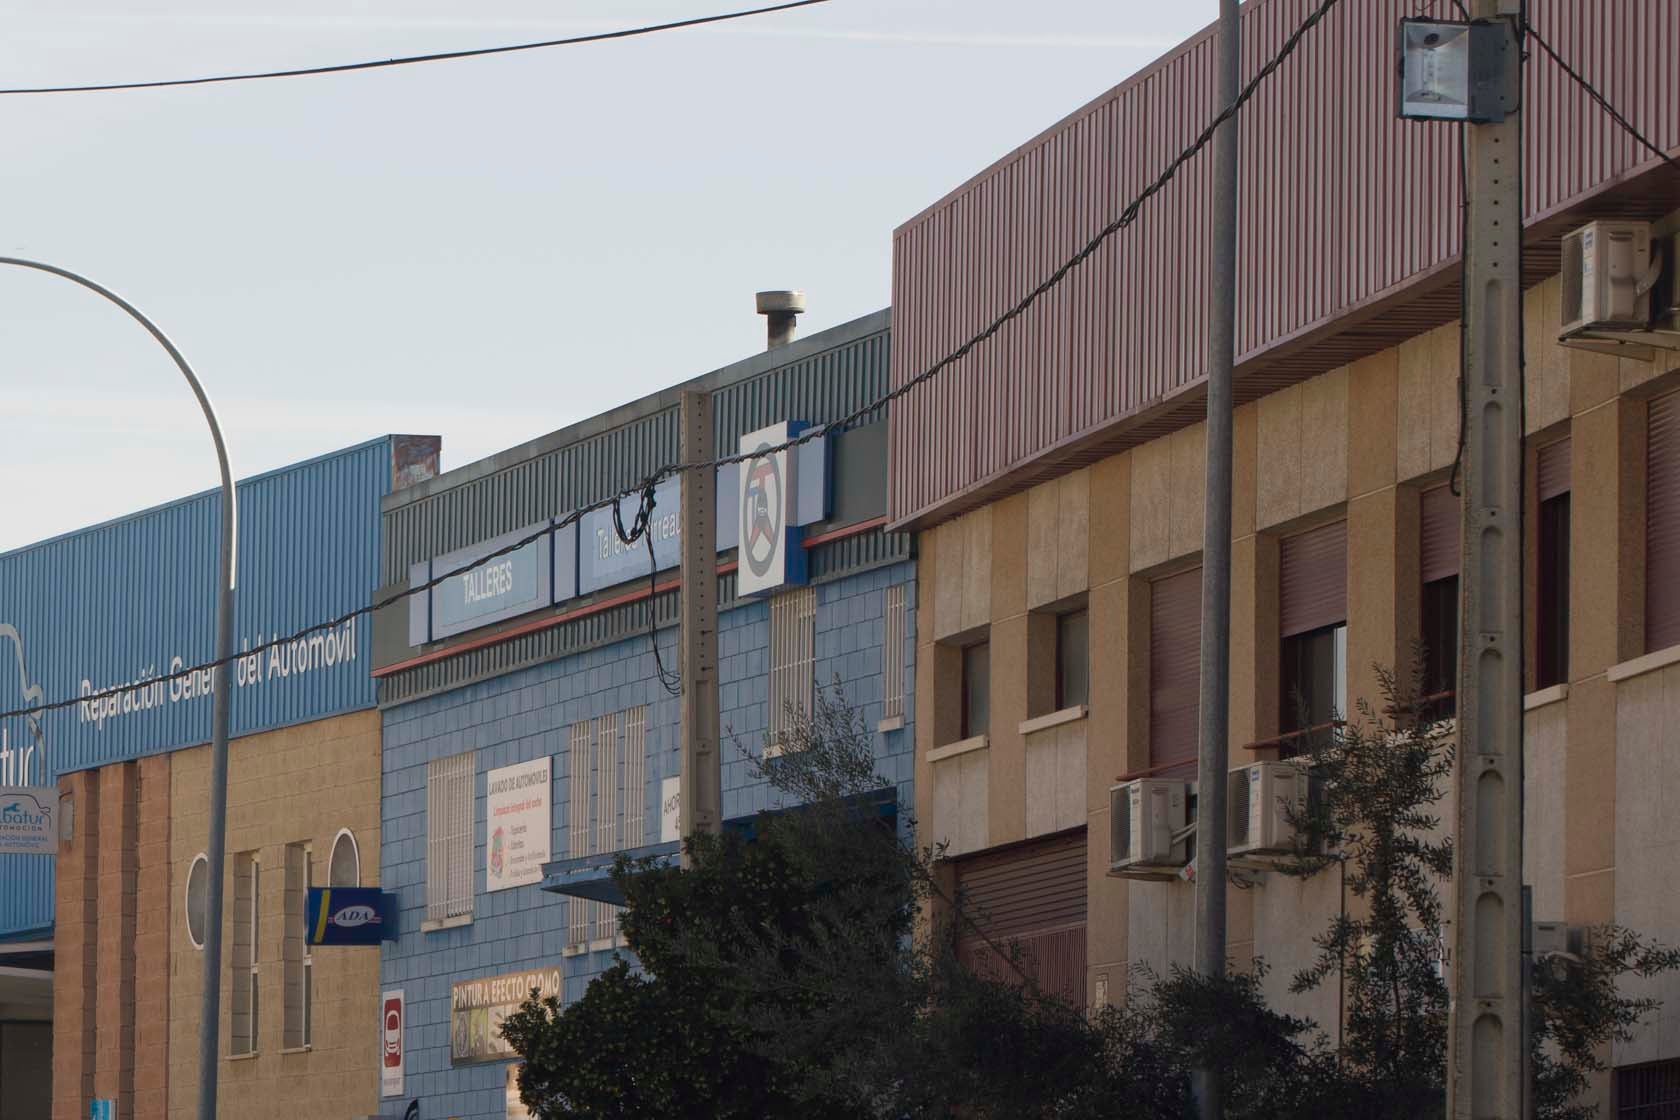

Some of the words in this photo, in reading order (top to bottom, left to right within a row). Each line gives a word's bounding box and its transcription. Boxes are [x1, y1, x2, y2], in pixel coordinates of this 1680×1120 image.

[462, 561, 513, 604] TALLERES
[80, 664, 163, 730] Reparación
[169, 656, 219, 702] Gener
[237, 634, 262, 687] del
[268, 616, 356, 681] Automóvil
[509, 775, 516, 792] DE
[338, 911, 369, 921] ADA
[453, 983, 490, 1009] PINTURA
[491, 977, 524, 1003] EFECTO
